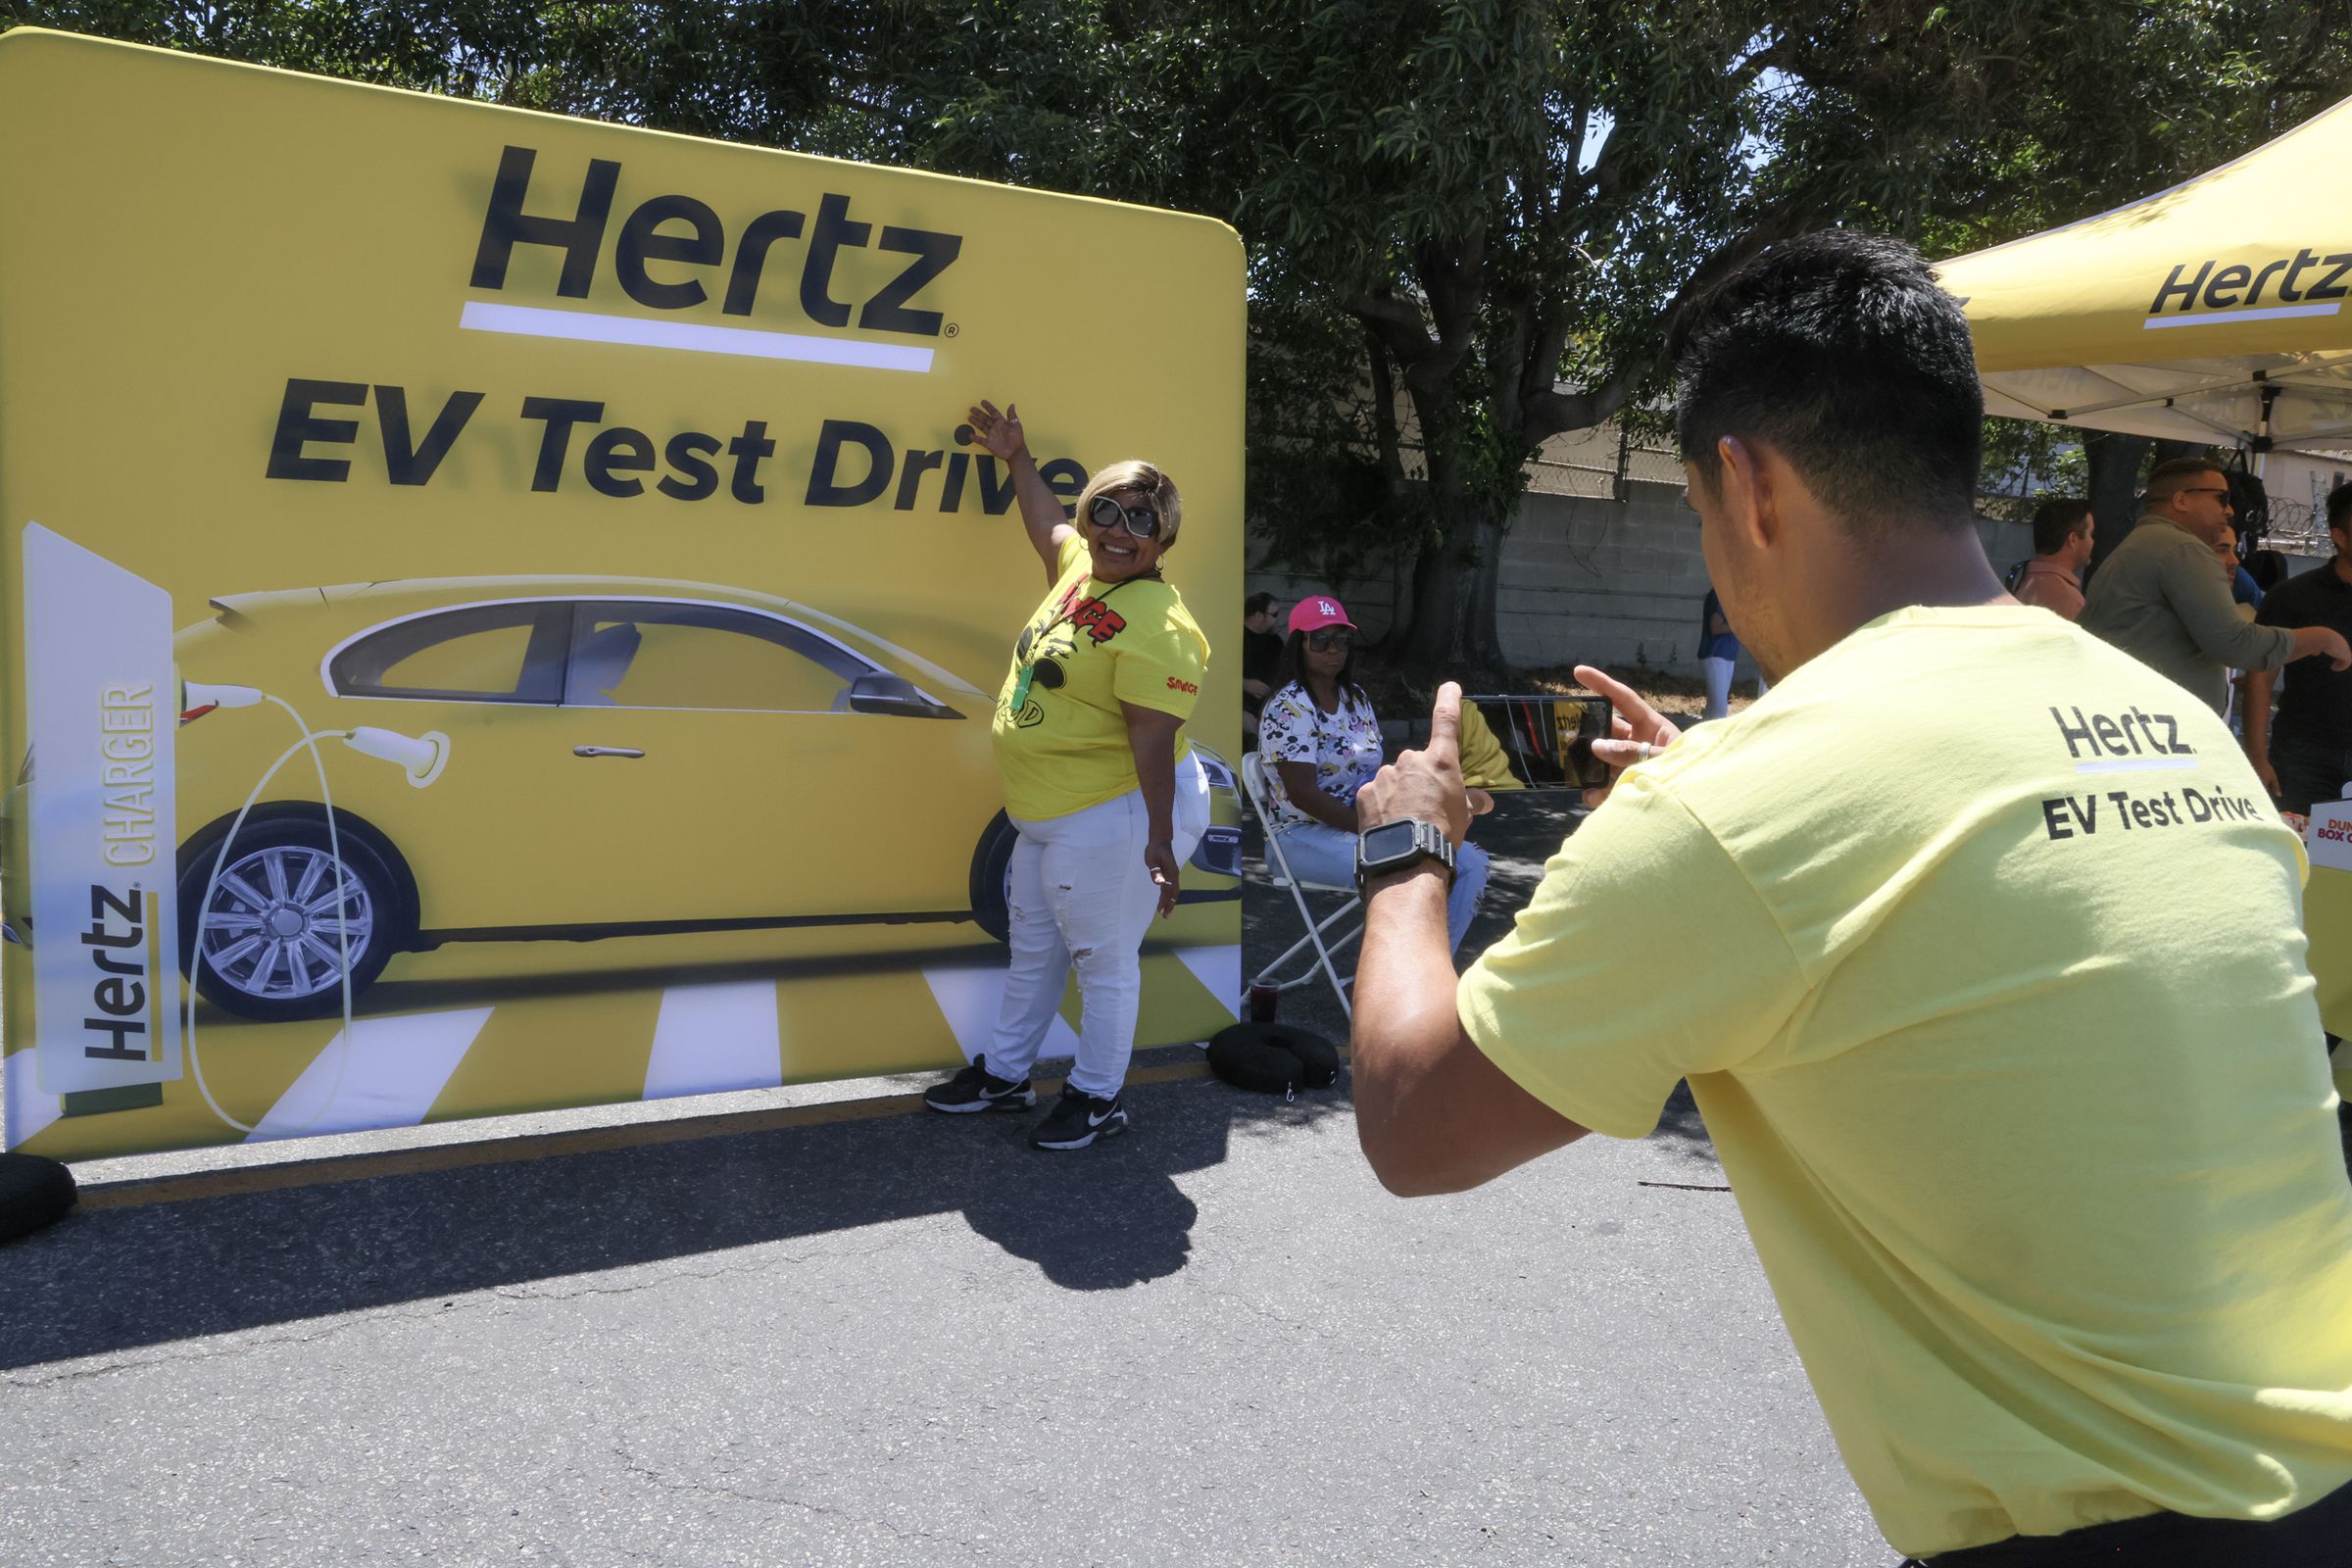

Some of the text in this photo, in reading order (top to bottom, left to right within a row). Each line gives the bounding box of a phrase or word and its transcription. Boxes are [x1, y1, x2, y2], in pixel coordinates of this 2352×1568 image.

[469, 145, 963, 336] Hertz
[2148, 248, 2352, 314] Hertz
[266, 378, 486, 486] EV
[520, 396, 776, 505] Test
[1317, 600, 1337, 615] LA
[2048, 706, 2194, 759] Hertz
[102, 683, 155, 867] CHARGER
[2041, 785, 2265, 840] EV Test Drive
[2318, 828, 2344, 842] BOX
[80, 885, 147, 1062] Hertz
